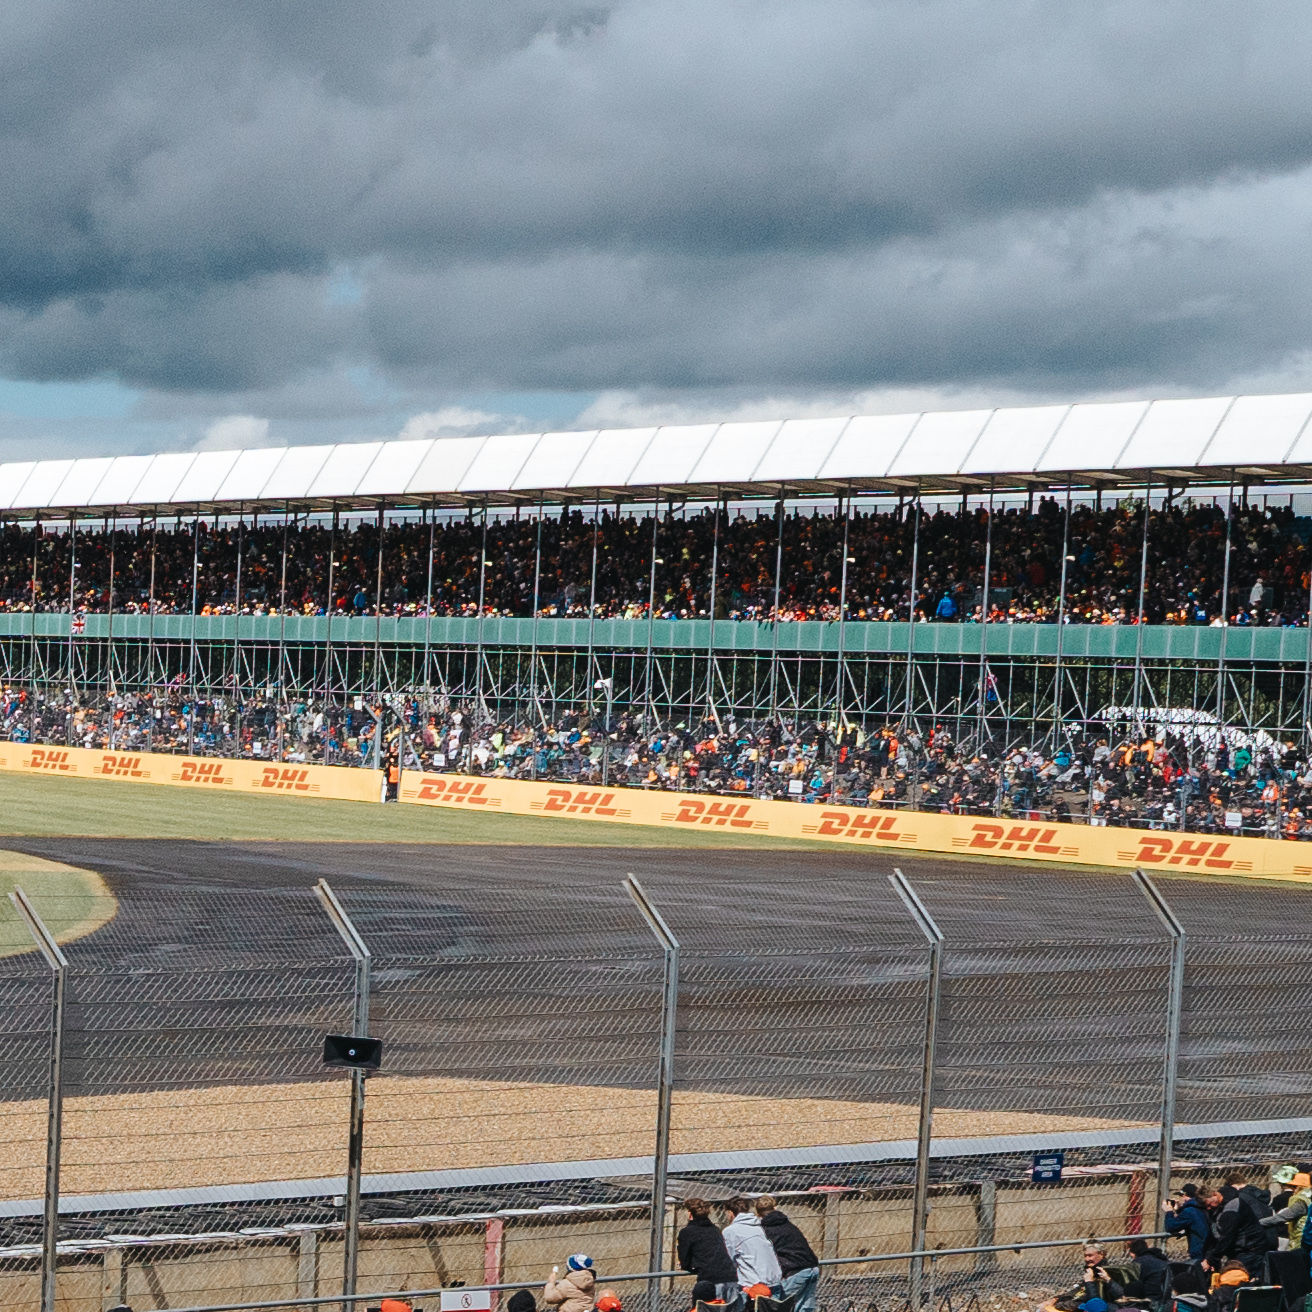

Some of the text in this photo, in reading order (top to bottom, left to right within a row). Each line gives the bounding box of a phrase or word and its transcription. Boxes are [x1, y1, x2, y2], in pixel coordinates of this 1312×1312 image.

[31, 750, 71, 770] DHL
[102, 756, 143, 777] DHL
[181, 763, 226, 784] DHL
[262, 768, 311, 791] DHL
[419, 778, 489, 805] DHL
[544, 789, 619, 816] DHL
[676, 801, 755, 828] DHL
[818, 812, 902, 841] DHL
[970, 824, 1063, 855] DHL
[1136, 837, 1236, 869] DHL
